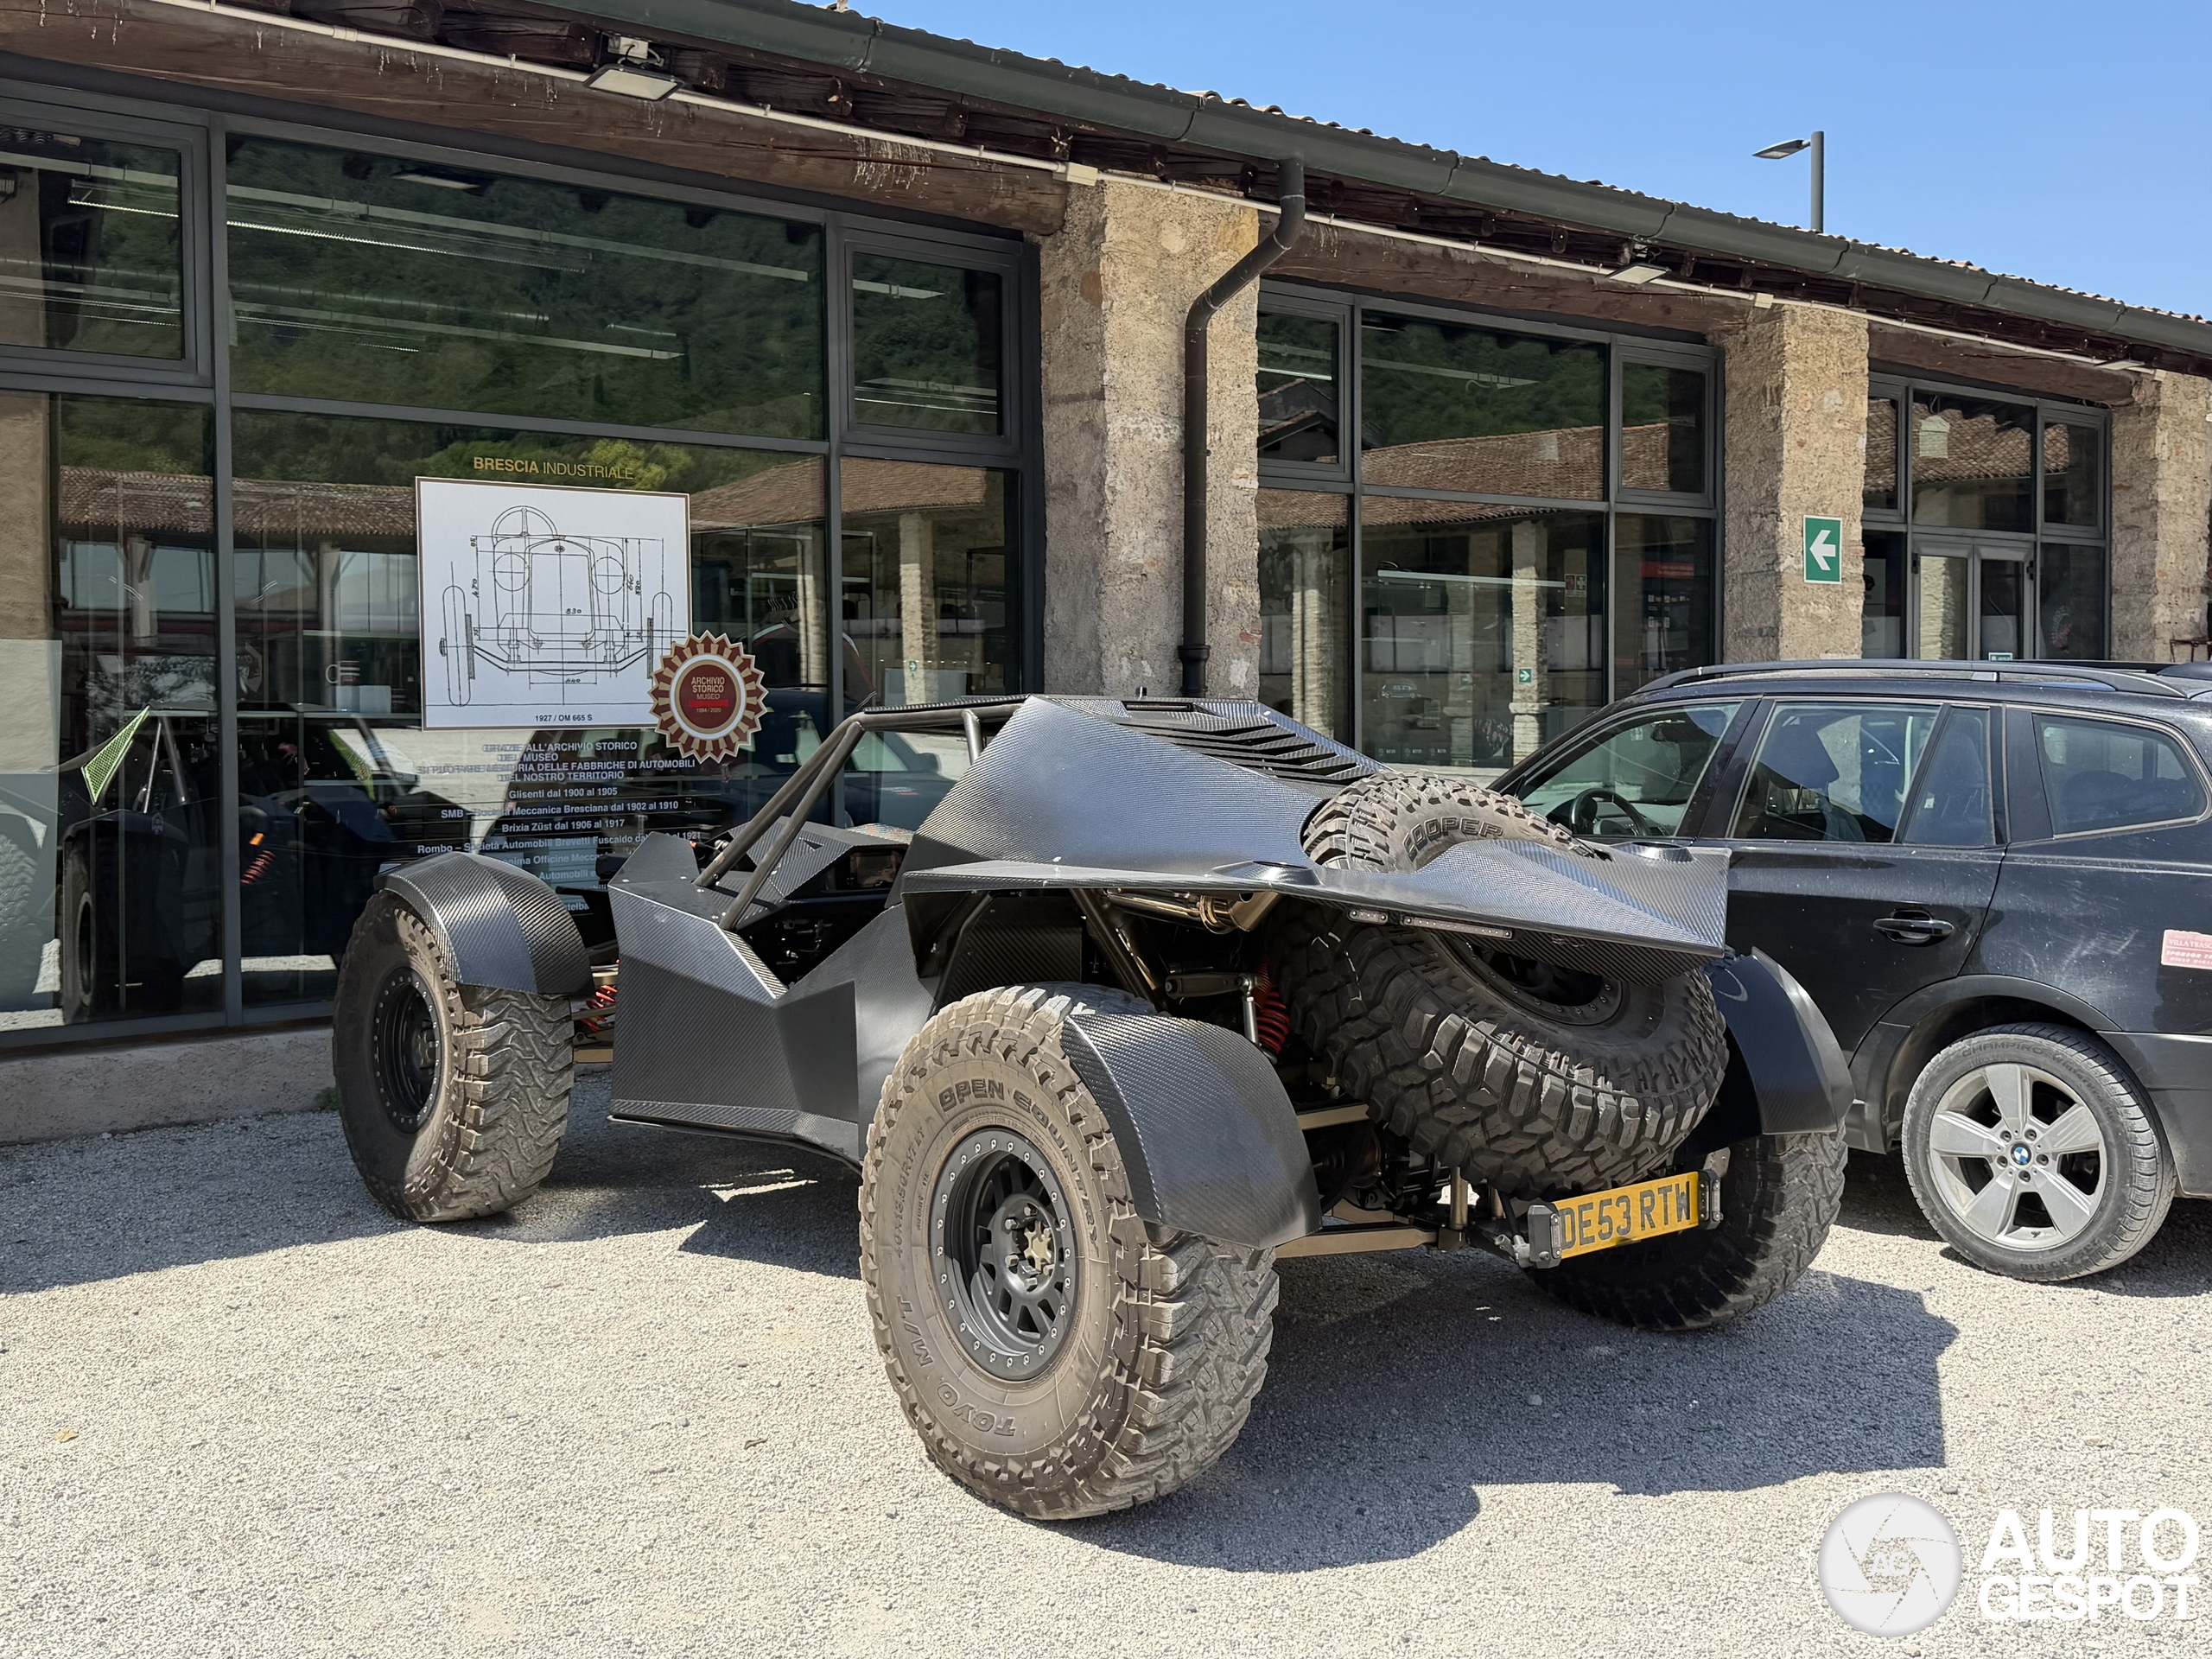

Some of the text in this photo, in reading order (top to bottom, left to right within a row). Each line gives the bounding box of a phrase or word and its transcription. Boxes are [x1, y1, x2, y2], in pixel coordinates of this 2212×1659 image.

[474, 456, 633, 480] BRESCIA INDUSTRIALE
[692, 684, 724, 693] STORICO
[525, 742, 594, 753] ALL'ARCHIVIO
[595, 741, 638, 751] STORICO
[523, 753, 559, 762] MUSEO
[537, 762, 568, 772] DELLE
[571, 761, 626, 771] FABBRICHE
[628, 760, 638, 770] DI
[639, 760, 696, 770] AUTOMOBILI
[523, 772, 564, 782] NOSTRO
[567, 771, 625, 781] TERRITORIO
[509, 787, 618, 799] Glisenti dal 1900 al 1905
[441, 809, 464, 819] SMB
[512, 805, 562, 817] Meccanica
[563, 804, 609, 815] Bresciana
[611, 802, 624, 811] dal
[626, 802, 647, 810] 1902
[649, 801, 657, 810] al
[658, 800, 678, 810] 1910
[502, 818, 625, 833] Brixia Züst dal 1906 al 1917
[417, 843, 453, 854] Rombo
[502, 839, 553, 849] Automobili
[556, 836, 590, 847] Brevetti
[593, 835, 633, 845] Fuscaldo
[533, 855, 569, 865] Officine
[539, 868, 588, 880] Automobili
[1961, 1042, 2043, 1058] CHAMPIRO
[938, 1077, 1004, 1113] OPEN
[1559, 1194, 1632, 1252] DE53
[937, 1382, 1016, 1437] TOYO
